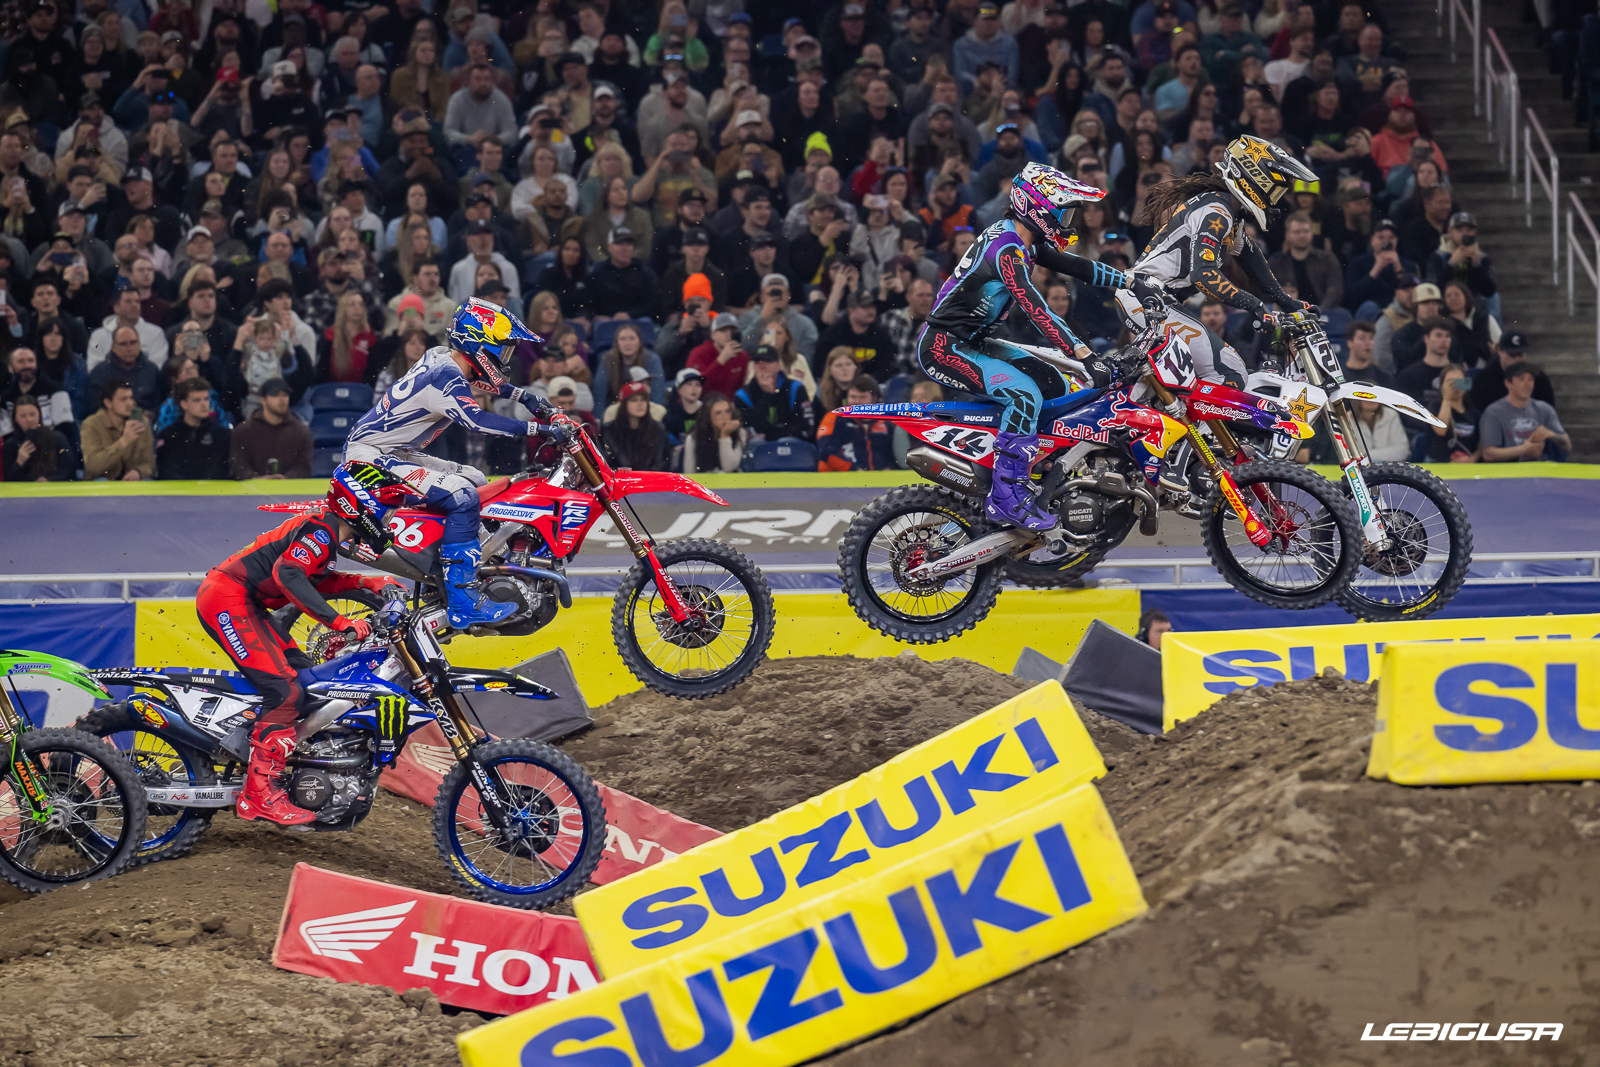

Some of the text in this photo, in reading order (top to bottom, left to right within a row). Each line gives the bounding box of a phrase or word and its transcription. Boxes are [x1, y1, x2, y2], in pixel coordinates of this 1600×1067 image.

[1238, 154, 1269, 190] 100%
[1022, 182, 1056, 211] OAKLEY
[1239, 178, 1266, 210] ROCKSTAR
[1028, 208, 1054, 236] Red Bull
[1202, 269, 1239, 299] FXR
[477, 355, 504, 386] Red Bull
[1163, 341, 1194, 387] 14
[963, 415, 994, 423] DUCATI
[1193, 402, 1209, 414] Troy
[1221, 405, 1252, 421] Designs
[934, 428, 988, 458] 14
[1052, 420, 1110, 444] Red Bull
[337, 496, 360, 517] FLY
[1224, 488, 1246, 516] DHL
[1352, 479, 1371, 514] MOTOREX
[361, 514, 381, 538] MONSTER
[487, 507, 536, 519] PROGRESSIVE
[562, 500, 589, 525] CRF
[936, 506, 971, 527] DUNLOP
[657, 568, 687, 610] DUNLOP
[222, 623, 250, 660] YAMAHA
[191, 676, 215, 685] YAMAHA
[326, 690, 371, 700] PROGRESSIVE
[193, 696, 223, 727] 1
[428, 698, 458, 739] KYB
[14, 761, 38, 797] MAXXIS
[473, 761, 502, 809] DUNLOP
[194, 791, 225, 800] YAMALUBE
[622, 717, 1060, 950] SUZUKI
[450, 854, 482, 888] DUNLOP
[519, 822, 1094, 1067] SUZUKI
